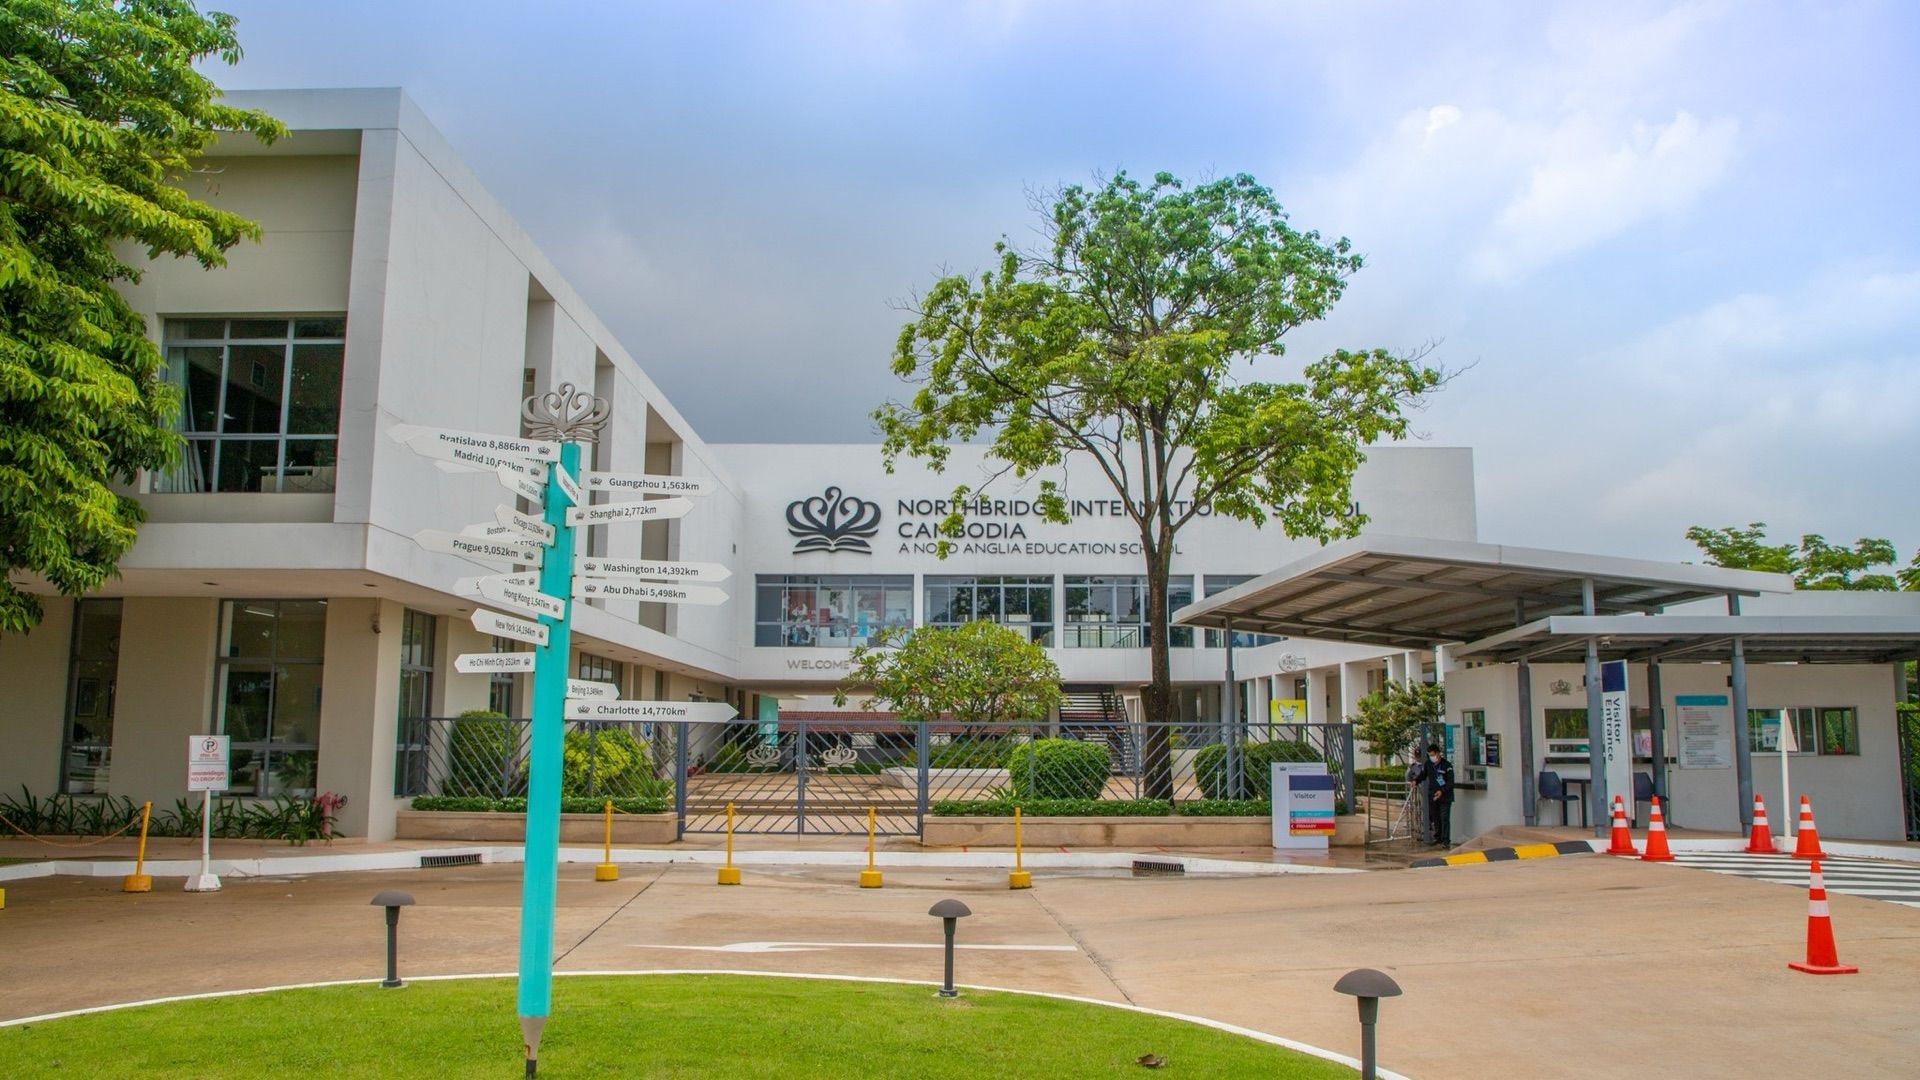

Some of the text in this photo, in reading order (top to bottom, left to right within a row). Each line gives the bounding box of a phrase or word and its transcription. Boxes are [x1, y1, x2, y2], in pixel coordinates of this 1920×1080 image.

[489, 440, 530, 453] 8,886km
[454, 449, 485, 464] Madrid
[609, 478, 700, 491] Guangzhou 1,563km
[590, 506, 657, 520] Shanghai 2,772km
[898, 499, 1063, 517] NORTHBRIDG
[898, 522, 1026, 539] CABODIA
[453, 539, 518, 558] Prague 9,052km
[899, 542, 909, 554] A
[914, 542, 959, 554] NOD
[963, 542, 1022, 555] ANGLIA
[1025, 542, 1116, 555] EDUCATION
[603, 563, 699, 576] Washington 14,392km
[504, 588, 518, 602] Hong
[518, 592, 531, 607] Kong
[603, 585, 686, 599] Abu Dhabi 5,498km
[495, 619, 505, 629] New
[506, 622, 516, 632] York
[496, 657, 504, 668] City
[787, 659, 850, 670] WELCOME
[597, 705, 686, 717] Charlotte 14,770km
[1613, 697, 1621, 744] Visitor
[1605, 699, 1613, 762] Entrance
[1294, 792, 1317, 800] Visitor
